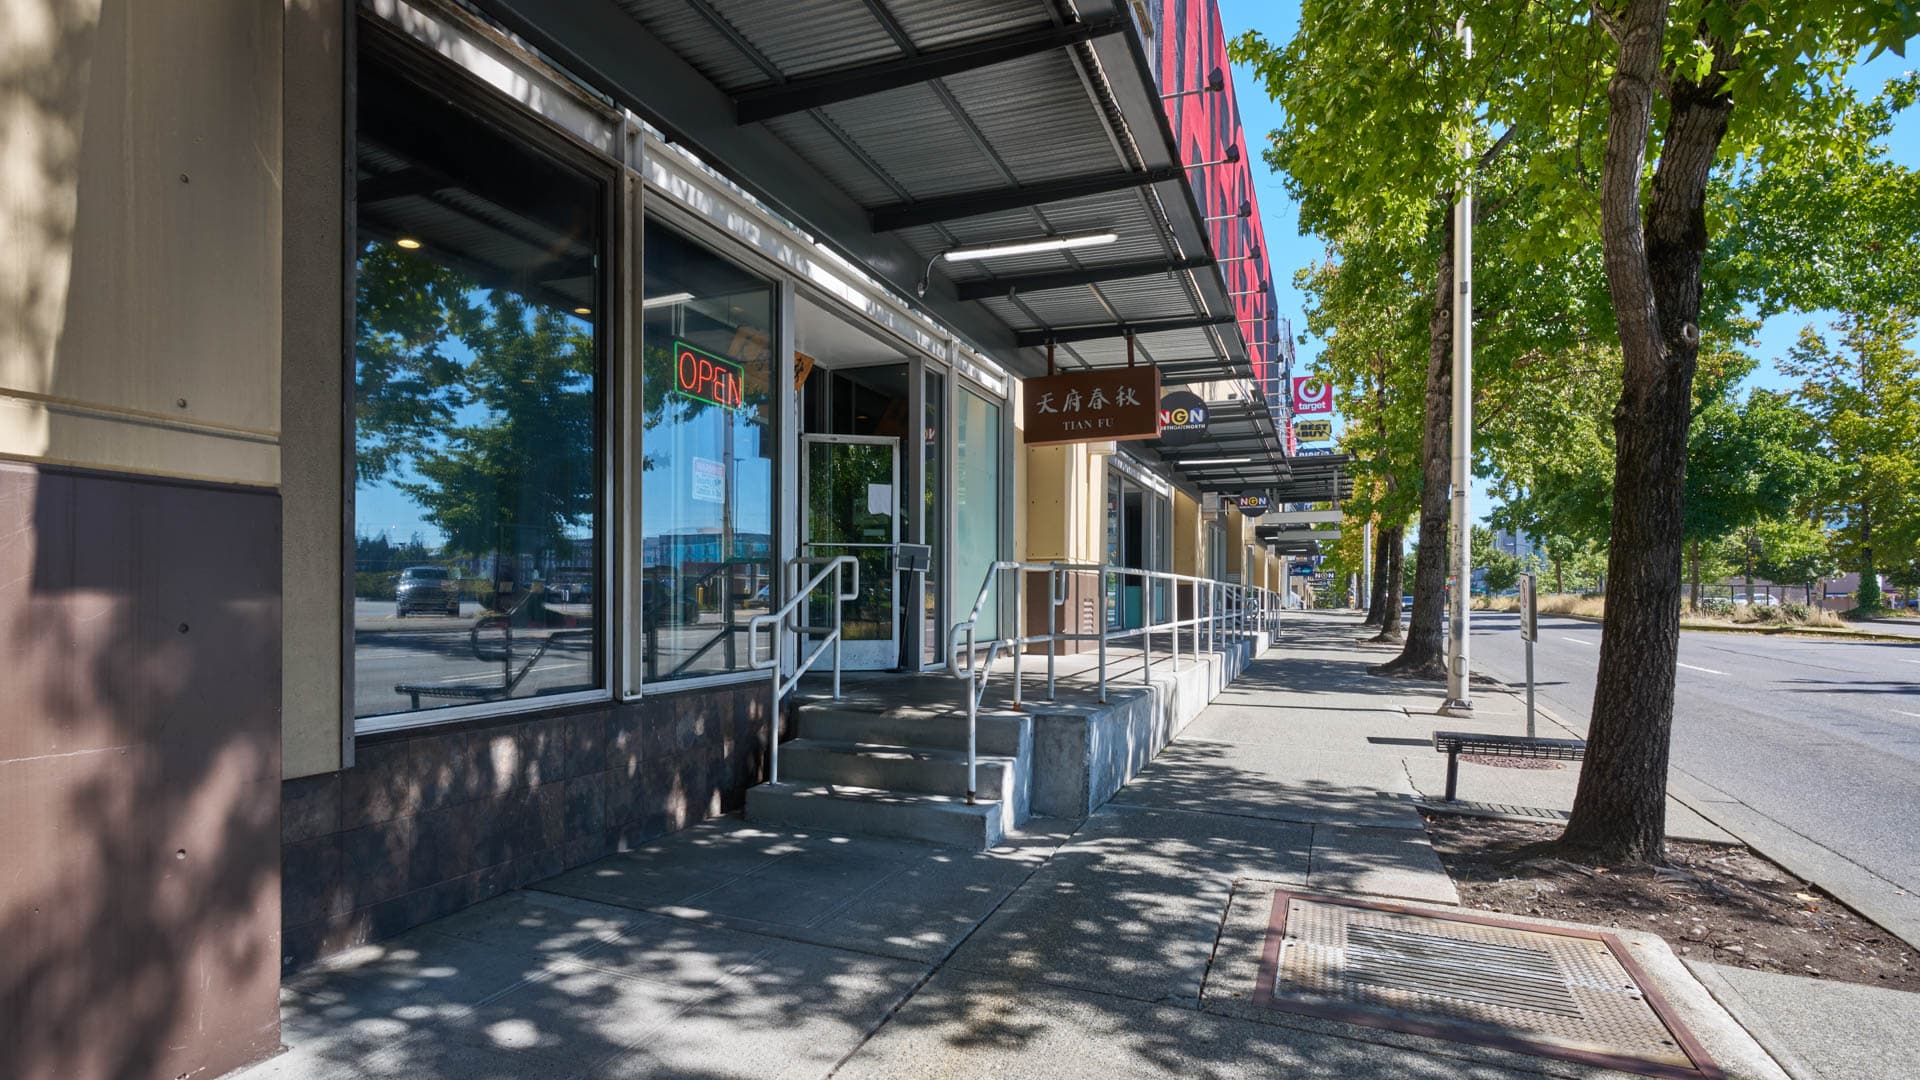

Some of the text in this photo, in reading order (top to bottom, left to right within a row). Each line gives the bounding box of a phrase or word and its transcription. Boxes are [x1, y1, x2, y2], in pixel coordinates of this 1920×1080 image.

[679, 352, 742, 409] OPEN
[1036, 385, 1141, 414] 天府春秋
[1298, 401, 1326, 411] target
[1062, 417, 1114, 431] TIAN FU
[1300, 423, 1329, 431] BEST
[1240, 496, 1267, 506] NGN
